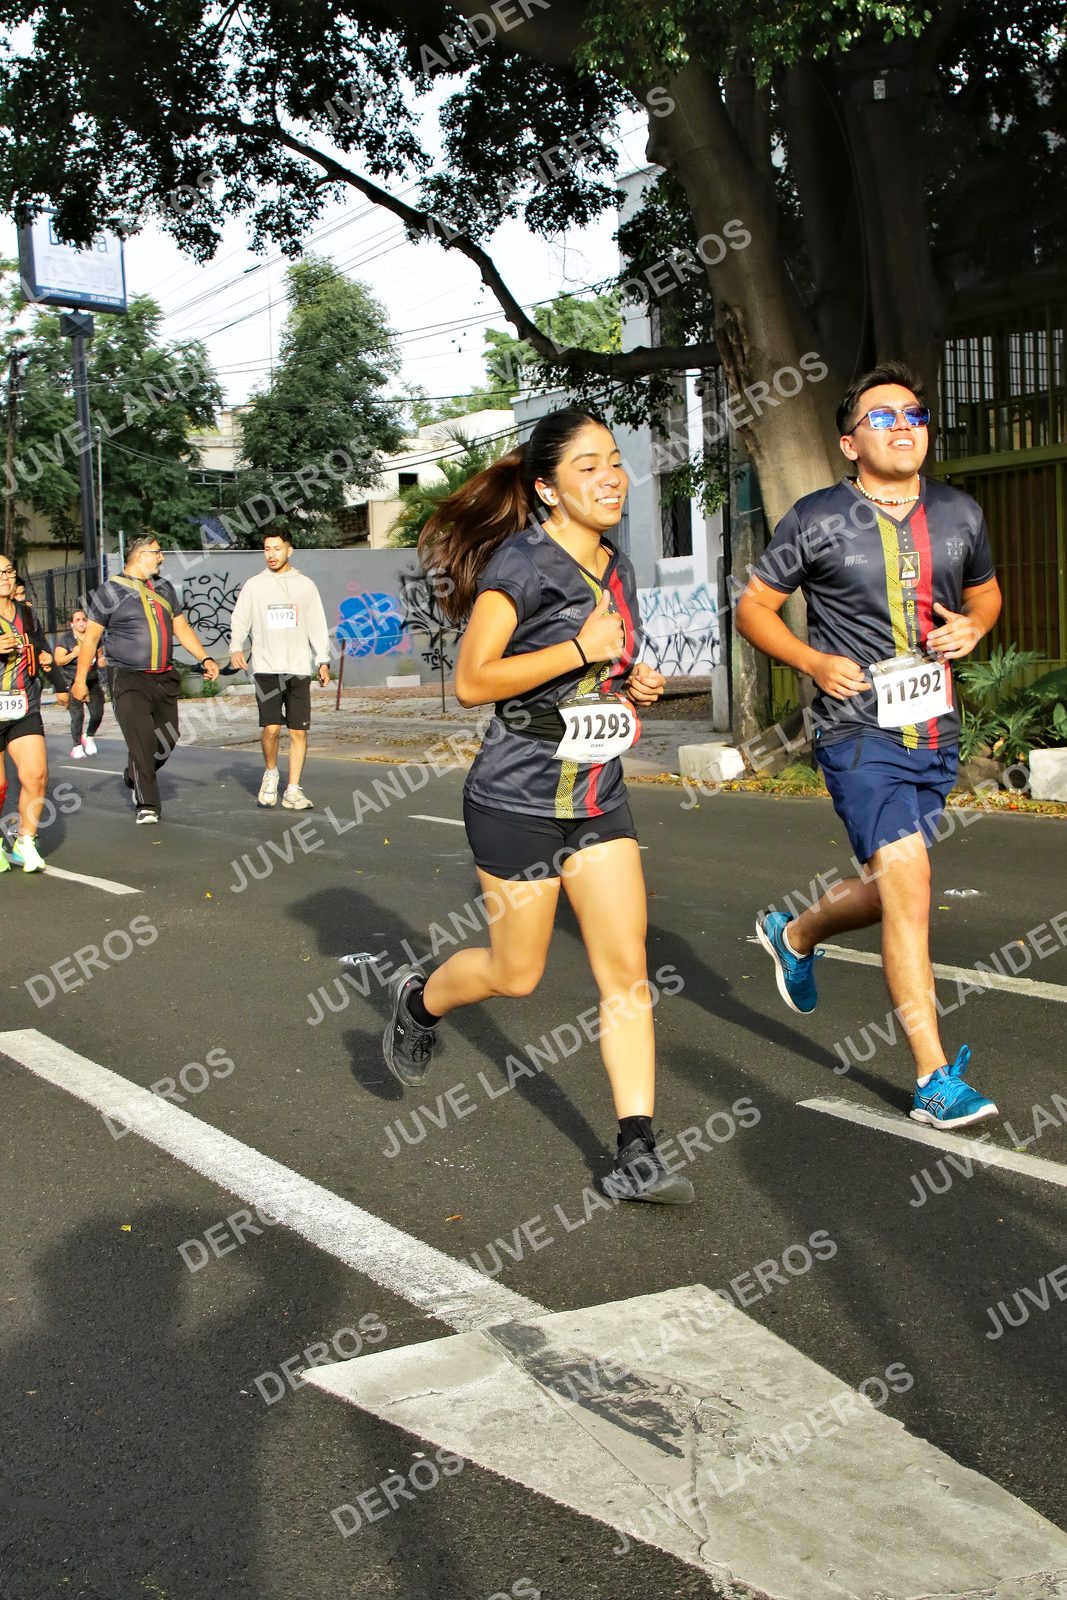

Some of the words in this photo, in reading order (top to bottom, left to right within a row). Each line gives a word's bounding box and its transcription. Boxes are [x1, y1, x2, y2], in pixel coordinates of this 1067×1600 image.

[184, 572, 229, 589] TOY
[270, 611, 294, 620] 11972
[881, 670, 941, 704] 11292
[570, 713, 630, 740] 11293
